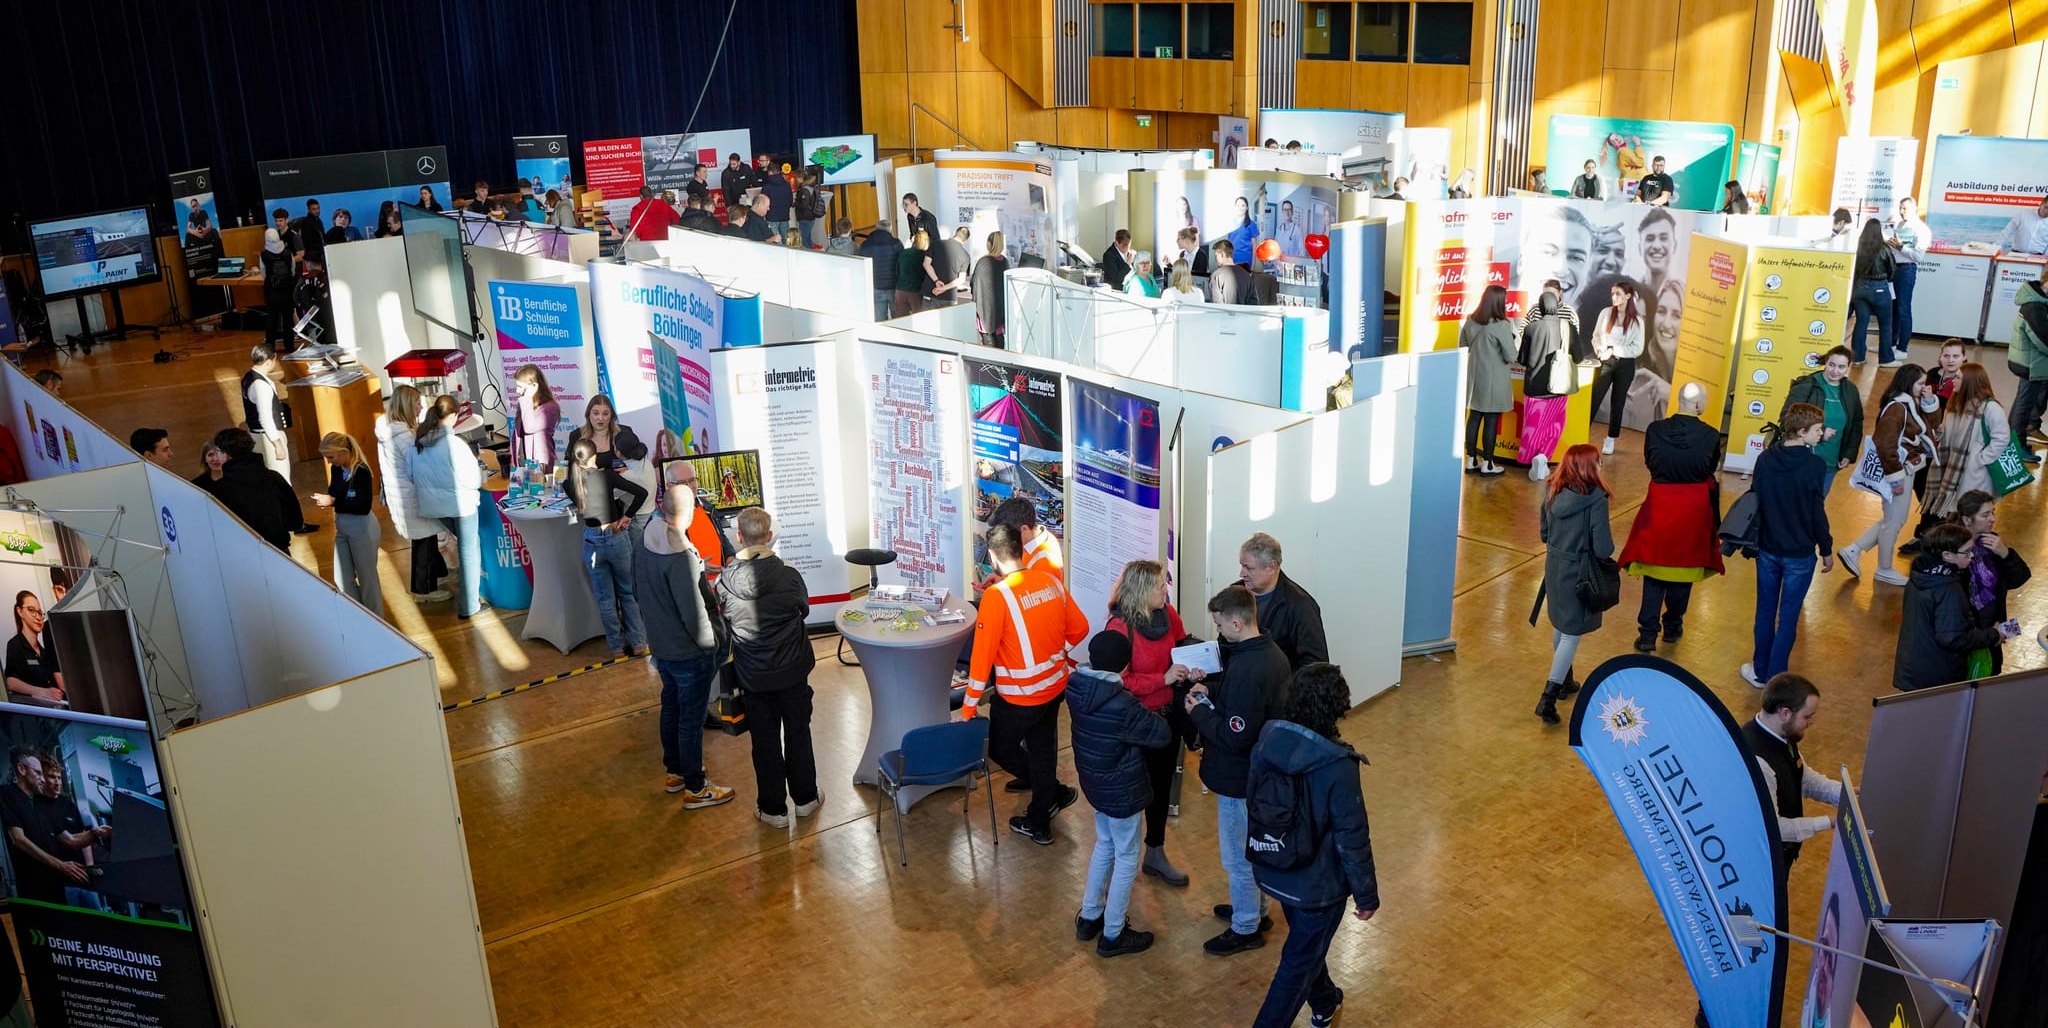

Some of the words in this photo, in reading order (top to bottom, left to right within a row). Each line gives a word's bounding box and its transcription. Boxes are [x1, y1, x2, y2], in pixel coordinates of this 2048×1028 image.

[601, 152, 624, 160] SUCHEN
[957, 181, 1003, 190] PERSPEKTIVE
[1946, 181, 1999, 192] Ausbildung
[2001, 183, 2015, 192] bei
[2017, 184, 2033, 193] der
[1757, 257, 1780, 266] Unsere
[105, 268, 128, 278] PAINT
[523, 297, 568, 313] Berufliche
[620, 280, 688, 313] Berufliche
[689, 291, 714, 330] Schulen
[525, 310, 561, 325] Schulen
[527, 323, 570, 340] Böblingen
[653, 312, 703, 350] Böblingen
[764, 366, 816, 386] intermetric
[778, 384, 801, 392] richtige
[163, 512, 176, 536] 33
[496, 548, 531, 568] WEG
[48, 936, 84, 953] DEINE
[87, 943, 162, 967] AUSBILDUNG
[52, 952, 73, 967] MIT
[76, 956, 158, 982] PERSPEKTIVE!
